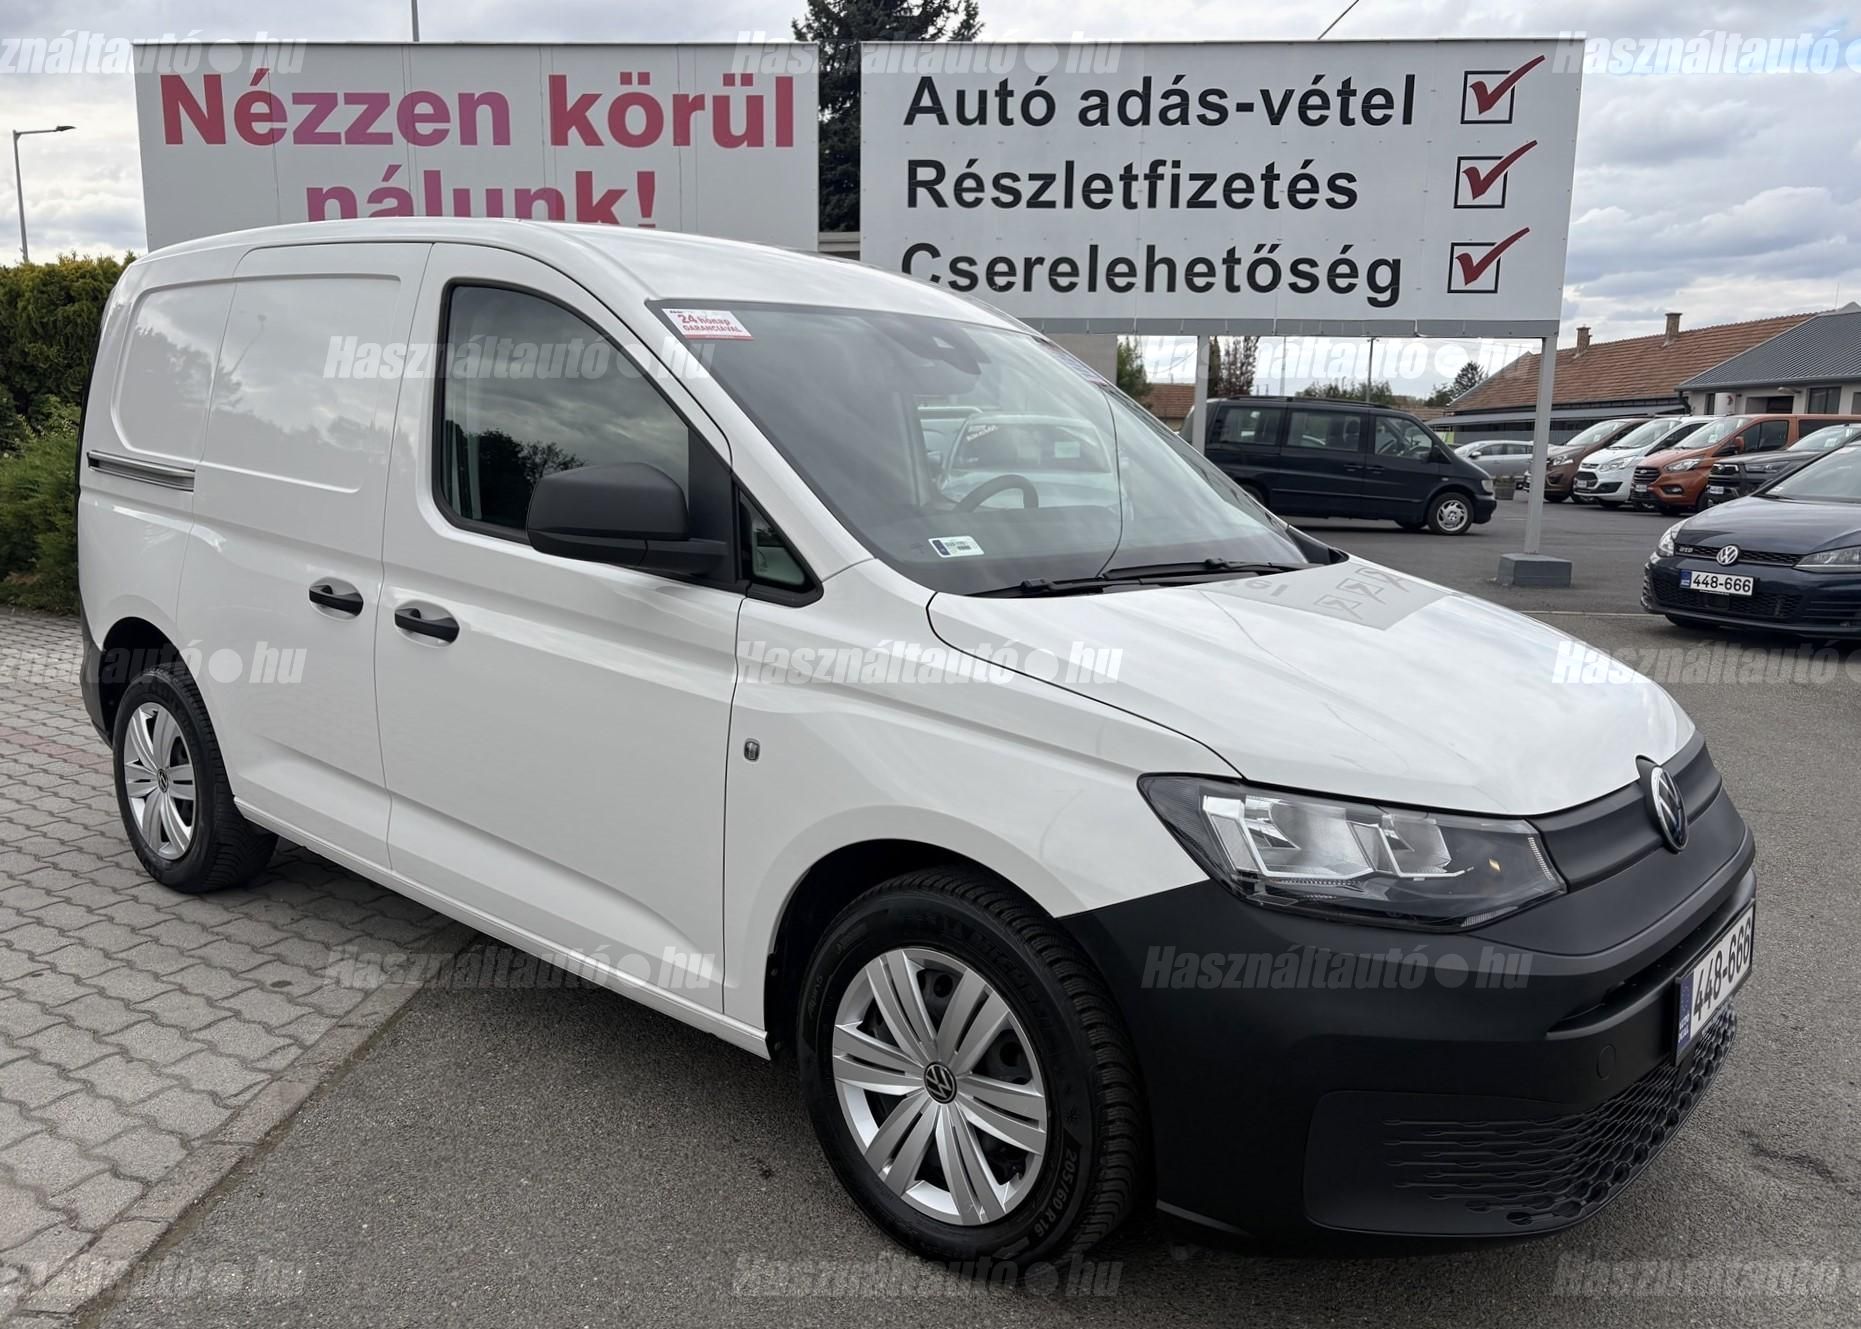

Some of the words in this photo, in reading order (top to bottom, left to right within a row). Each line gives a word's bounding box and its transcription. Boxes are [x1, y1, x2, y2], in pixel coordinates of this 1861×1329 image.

[161, 69, 509, 146] Nézzen
[550, 72, 794, 148] körül
[903, 75, 1056, 127] Autó
[1078, 74, 1416, 127] adás-vétel
[306, 164, 656, 228] nálunk!
[907, 158, 1358, 211] Részletfizetés
[901, 242, 1401, 308] Cserelehetőség
[1692, 573, 1752, 594] 448-666
[1693, 916, 1752, 1022] 448-666
[1053, 1148, 1078, 1210] 205/60
